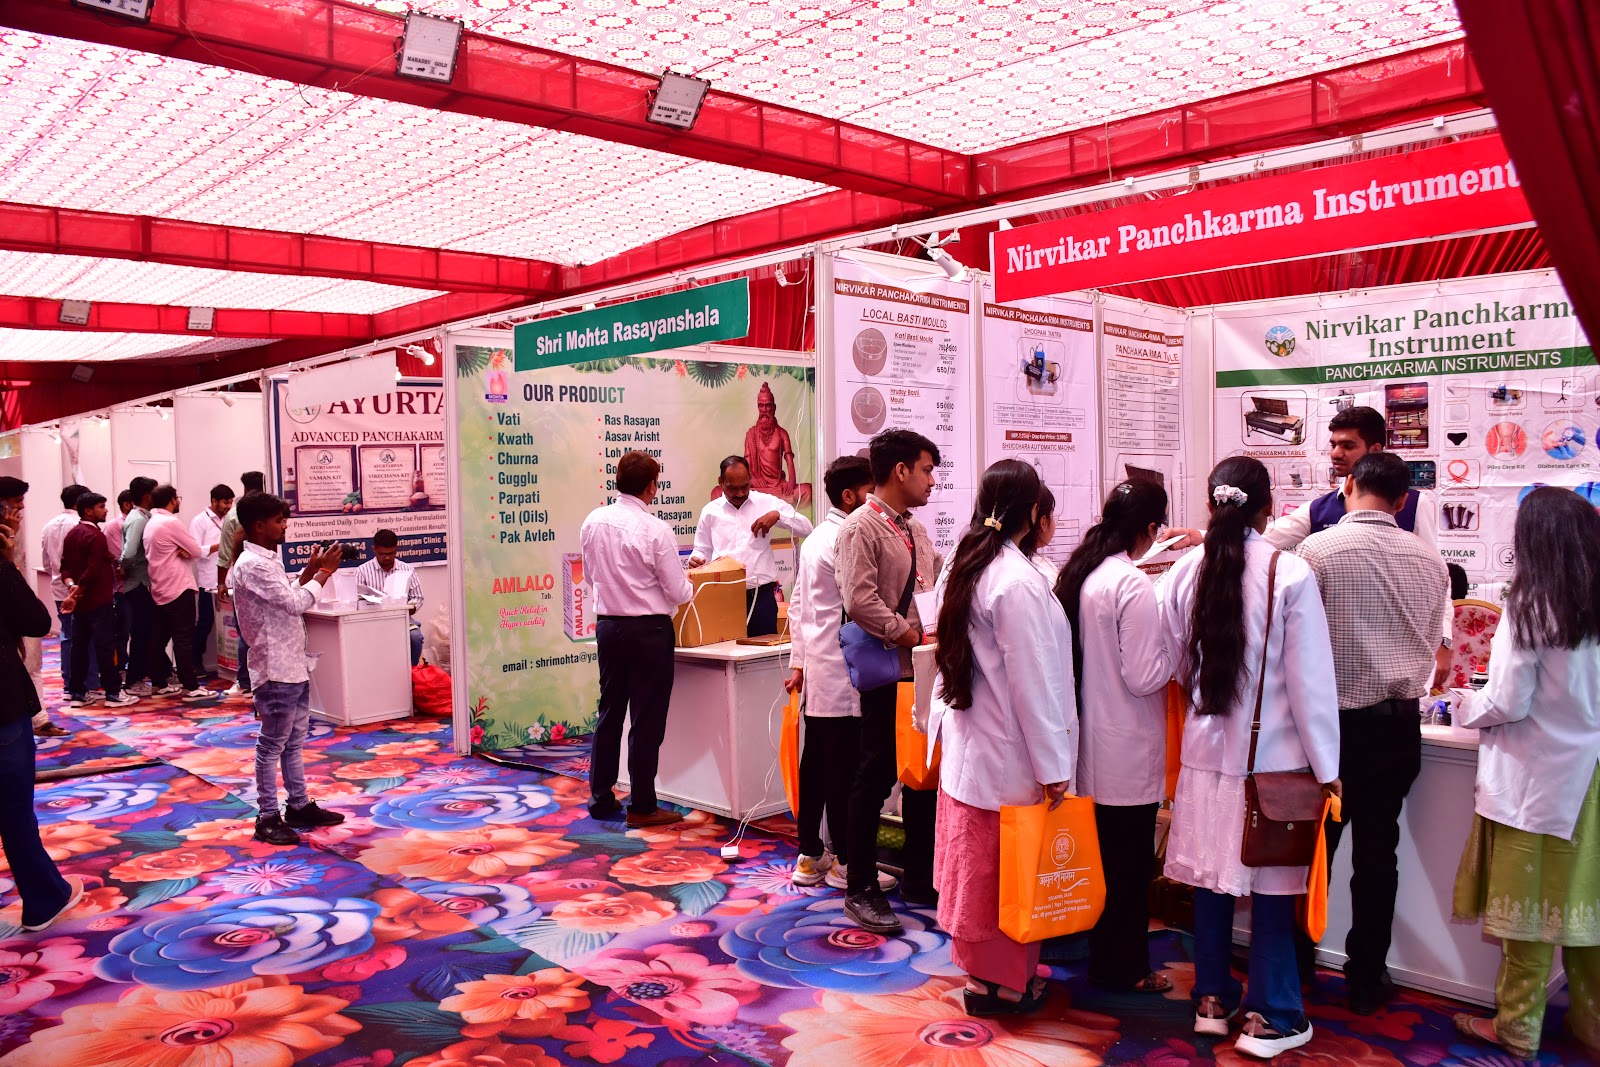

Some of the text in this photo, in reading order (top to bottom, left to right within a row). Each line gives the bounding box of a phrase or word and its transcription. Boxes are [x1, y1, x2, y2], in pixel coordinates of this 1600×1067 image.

[407, 56, 431, 65] MAHADEV
[1007, 162, 1520, 274] Nirvikar Panchkarma Instrument
[836, 282, 877, 296] NIRVIKAR
[878, 288, 931, 306] PANCHAKARMA
[862, 308, 895, 322] LOCAL
[897, 312, 922, 327] BASTI
[986, 306, 1015, 319] NIRVIKAR
[536, 304, 720, 356] Shri Mohta Rasayanshala
[1305, 315, 1405, 341] Nirvikar
[1369, 328, 1516, 358] Instrument
[1325, 351, 1562, 381] PANCHAKARMA INSTRUMENTS
[523, 383, 626, 404] OUR PRODUCT
[497, 412, 521, 426] Vati
[604, 414, 661, 428] Ras Rasayan
[291, 430, 445, 443] ADVANCED PANCHAKARM
[497, 432, 534, 446] Kwath
[605, 430, 660, 442] Aasav Arisht
[497, 452, 539, 465] Churna
[605, 447, 663, 459] Loh Mdoor
[498, 471, 538, 487] Gugglu
[499, 490, 540, 507] Parpati
[660, 494, 685, 506] Lavan
[293, 516, 368, 530] Pre-Measured Daily Dose
[377, 512, 447, 526] Ready-to-Use Formulation
[499, 509, 549, 526] Tel (Oils)
[657, 510, 692, 522] Rasayan
[294, 529, 350, 539] Saves Clinical Time
[400, 524, 428, 532] Consistent
[671, 524, 698, 536] dicine
[423, 536, 442, 545] Clinic
[500, 529, 555, 544] Pak Avleh
[1440, 549, 1476, 558] RVIKAR
[492, 573, 555, 594] AMLALO
[541, 592, 554, 600] Tab.
[499, 604, 549, 618] Quick Relief in
[573, 588, 584, 637] AMLALO
[500, 616, 546, 631] Hyper acidity
[502, 659, 528, 673] email
[1034, 903, 1052, 911] Ayurveda
[1063, 897, 1088, 906] Naturopathy
